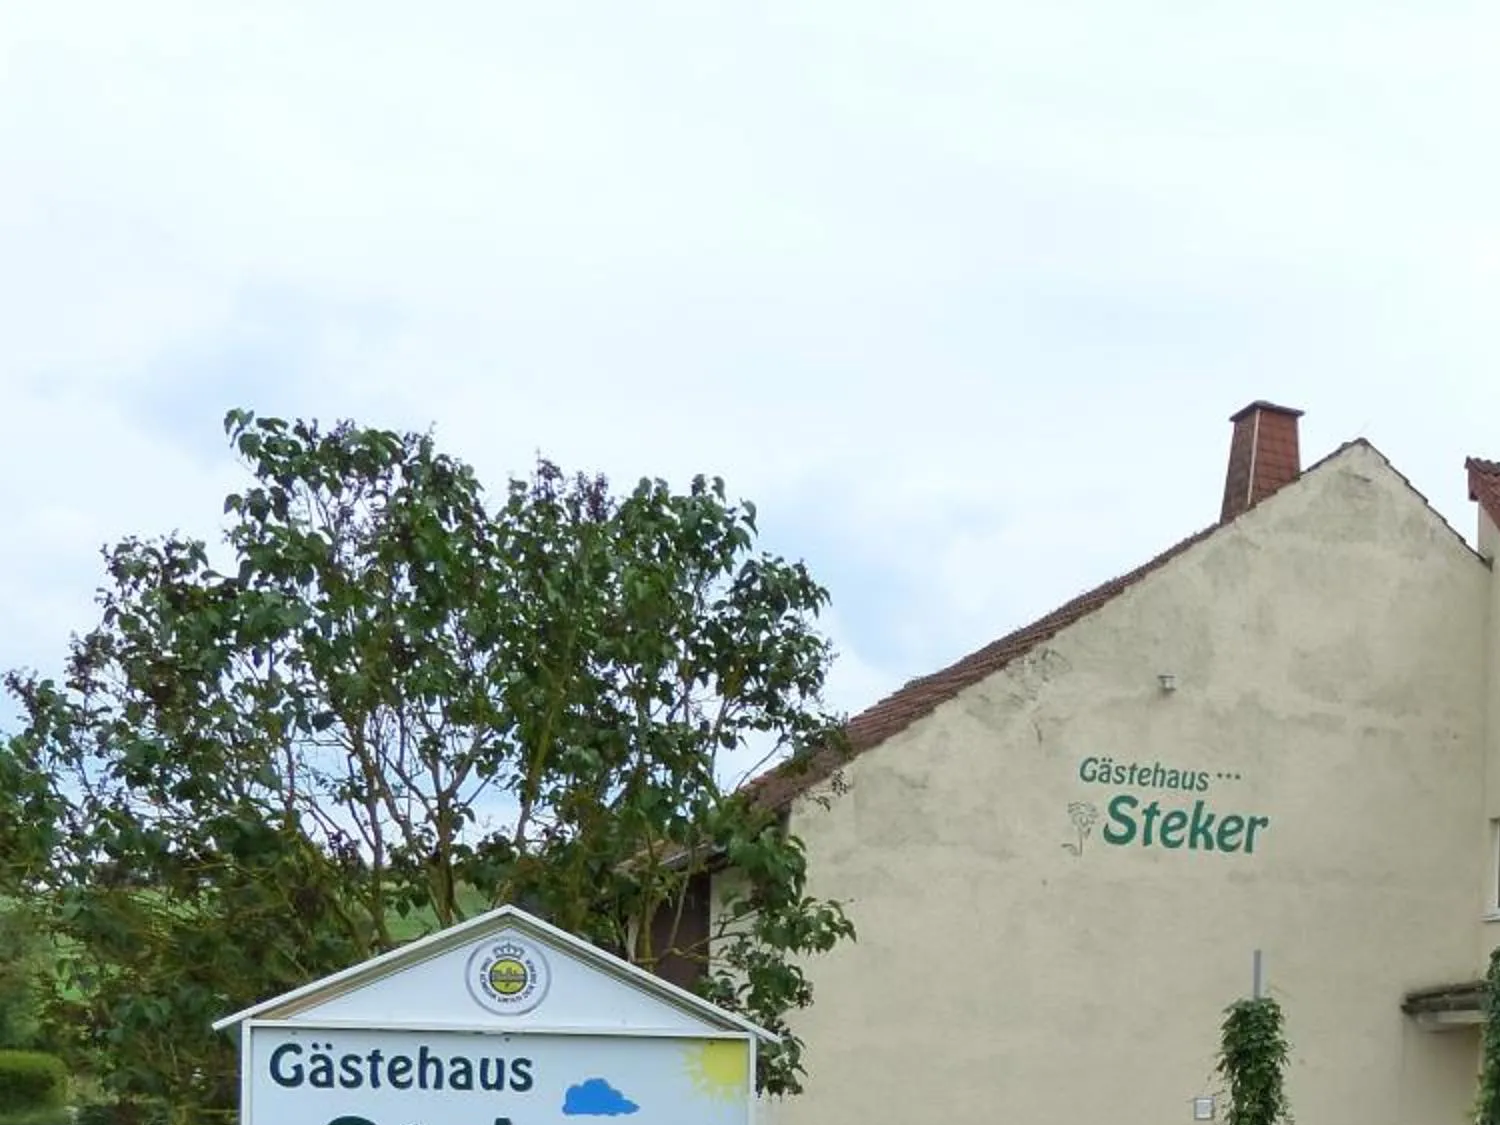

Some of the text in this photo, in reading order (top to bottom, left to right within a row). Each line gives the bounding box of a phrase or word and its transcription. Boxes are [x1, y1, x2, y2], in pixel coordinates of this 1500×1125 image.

[1079, 757, 1209, 791] Gästehaus
[1103, 795, 1269, 853] Steker
[269, 1042, 533, 1091] Gästehaus
